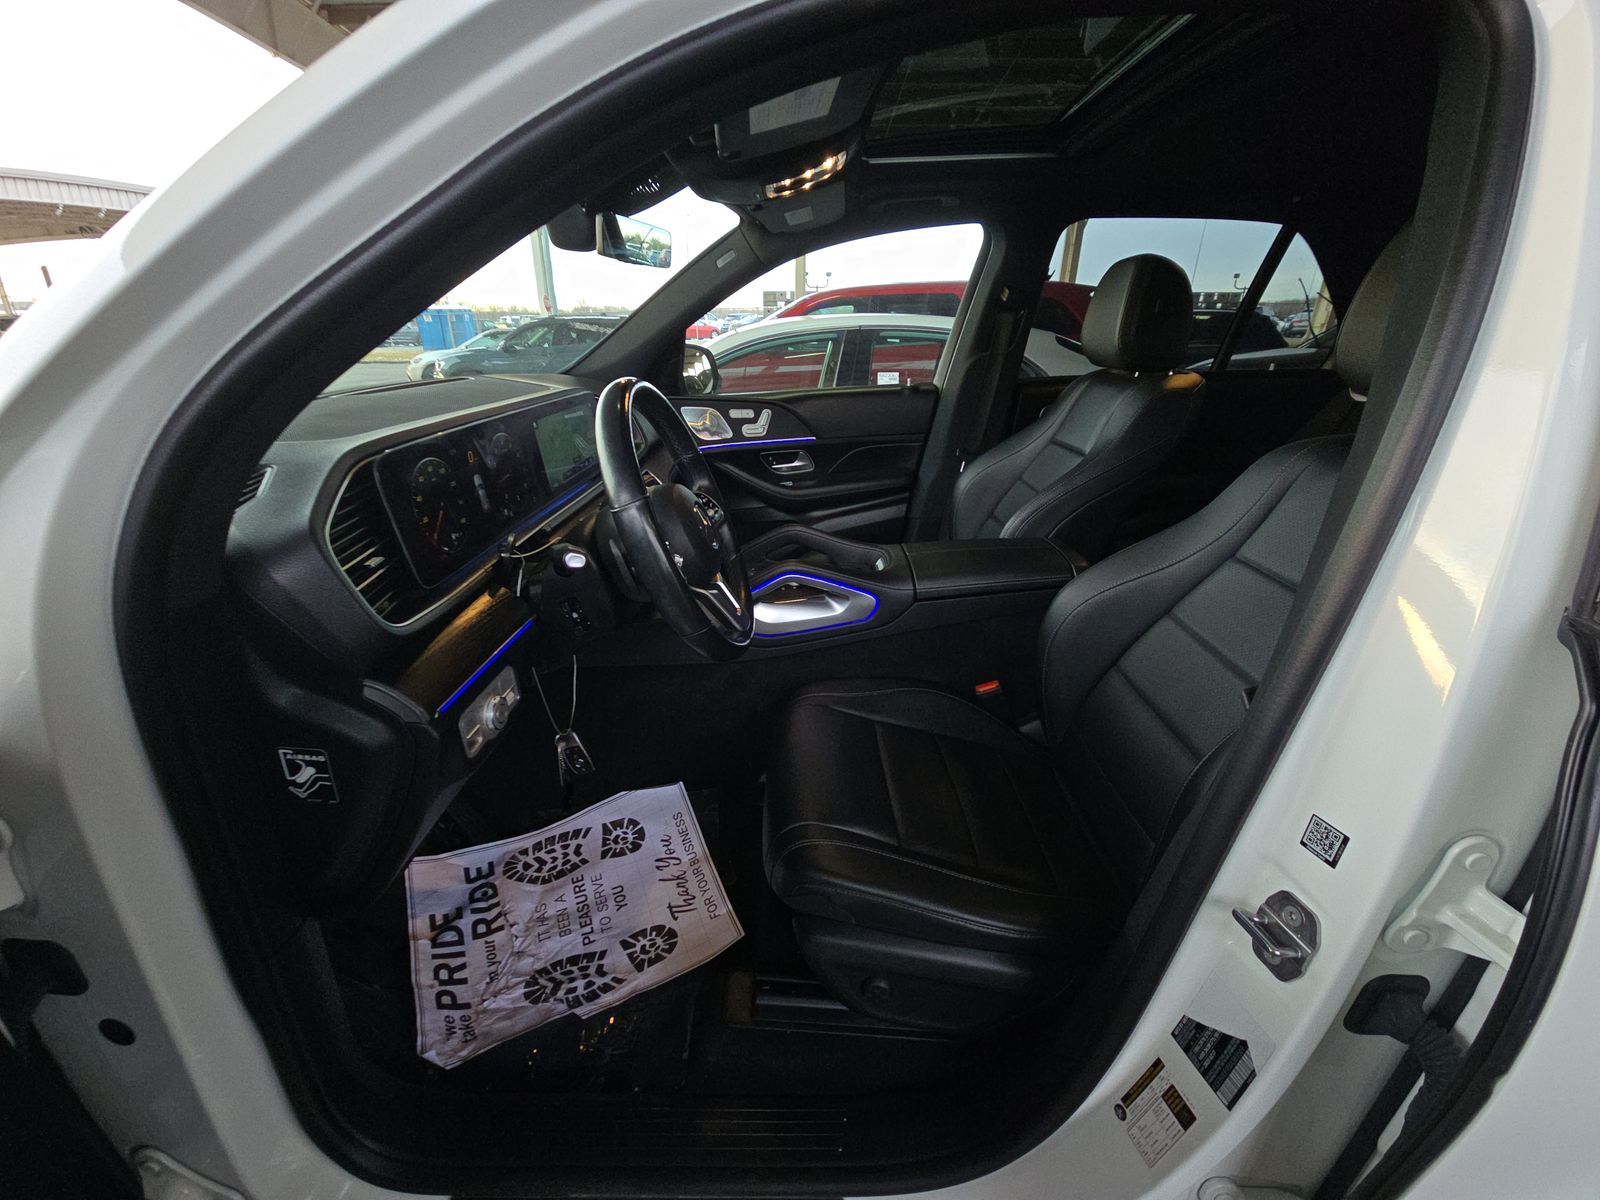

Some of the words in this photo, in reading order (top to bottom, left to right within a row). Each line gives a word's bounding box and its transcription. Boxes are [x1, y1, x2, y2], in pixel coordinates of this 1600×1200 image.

[654, 834, 682, 871] You
[673, 811, 700, 867] BUSINESS
[591, 873, 609, 912] SERVE
[658, 869, 698, 921] Thank
[692, 865, 711, 897] YOUR
[464, 861, 505, 941] RIDE
[554, 893, 567, 903] A
[571, 874, 596, 946] PLEASURE
[611, 884, 628, 912] YOU
[704, 895, 721, 920] FOR
[535, 903, 550, 927] HAS
[556, 907, 572, 938] BEEN
[600, 916, 614, 934] TO
[538, 931, 551, 943] IT
[429, 906, 472, 1010] PRIDE
[484, 940, 502, 968] your
[444, 1015, 457, 1036] we
[458, 1014, 477, 1043] take
